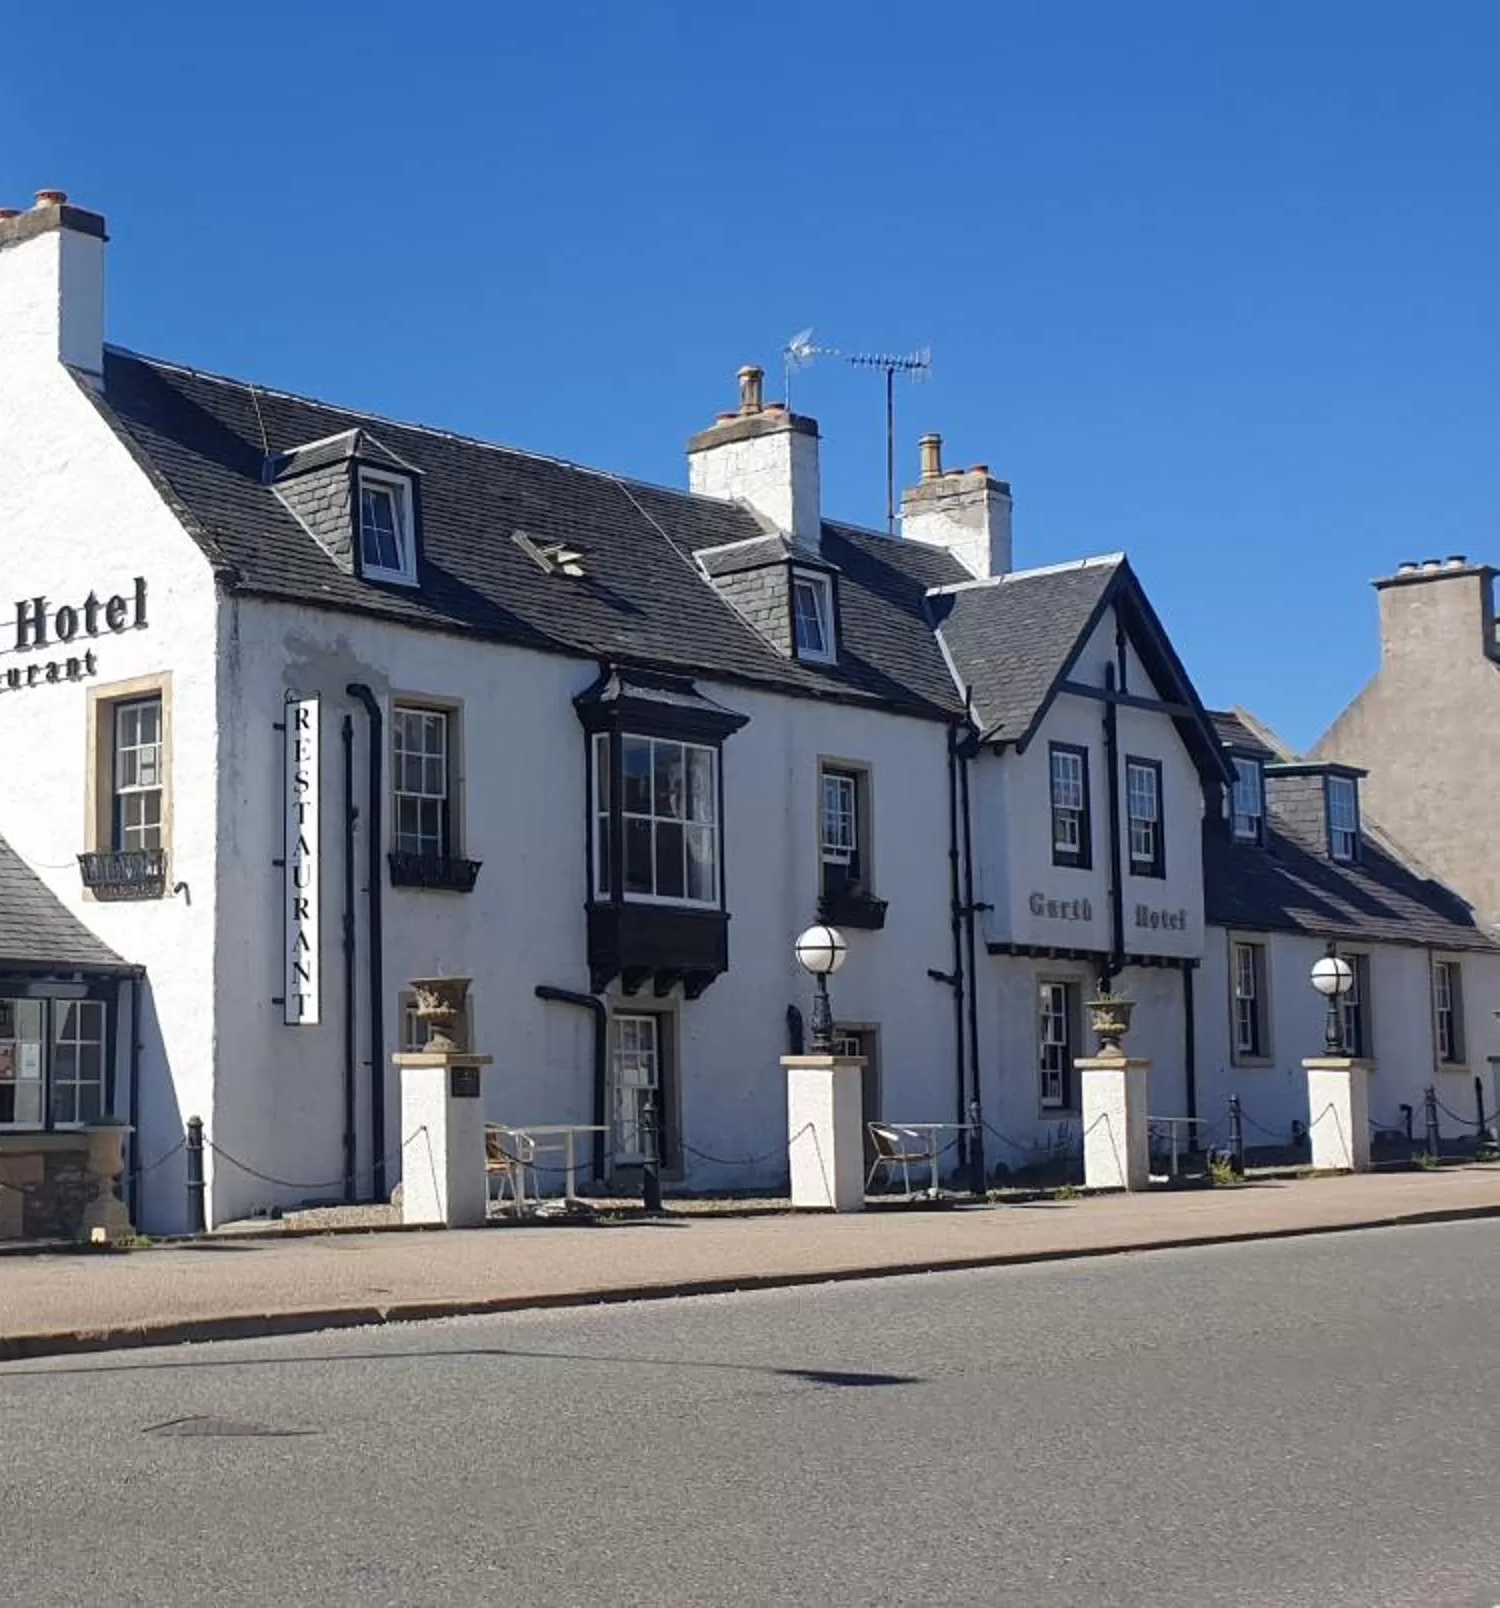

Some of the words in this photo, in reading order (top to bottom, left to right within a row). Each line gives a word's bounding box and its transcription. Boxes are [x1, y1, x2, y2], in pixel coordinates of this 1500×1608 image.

[14, 576, 148, 652] Hotel
[292, 708, 312, 1016] RESTAURANT
[1028, 891, 1092, 922] Garth
[1135, 902, 1188, 930] Hotel
